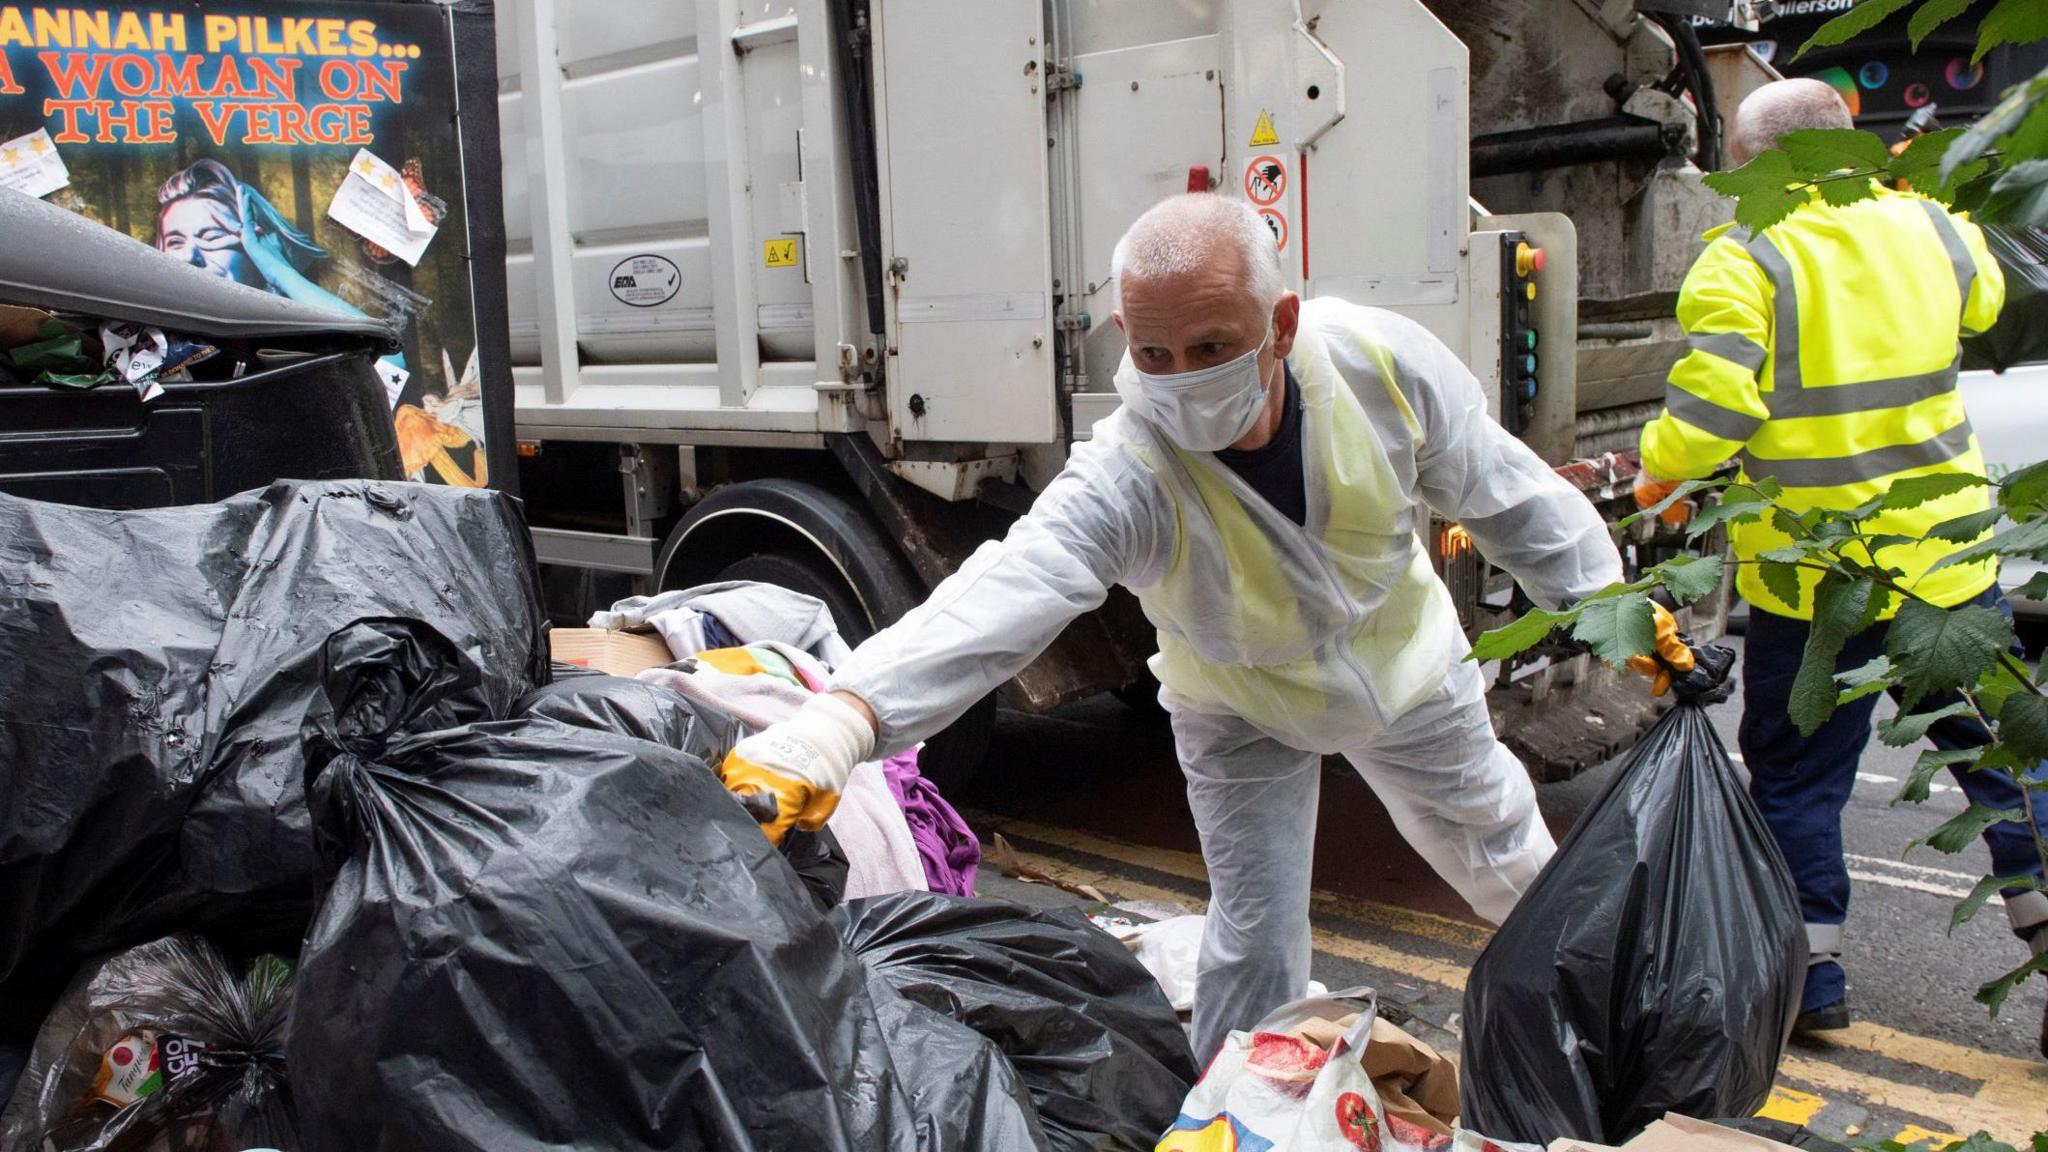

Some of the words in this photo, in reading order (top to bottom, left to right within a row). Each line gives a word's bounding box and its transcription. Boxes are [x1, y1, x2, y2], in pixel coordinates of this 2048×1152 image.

[204, 14, 421, 59] PILKES...
[38, 51, 303, 101] WOMAN
[319, 59, 409, 103] ON
[43, 98, 177, 143] THE
[192, 101, 374, 146] VERGE
